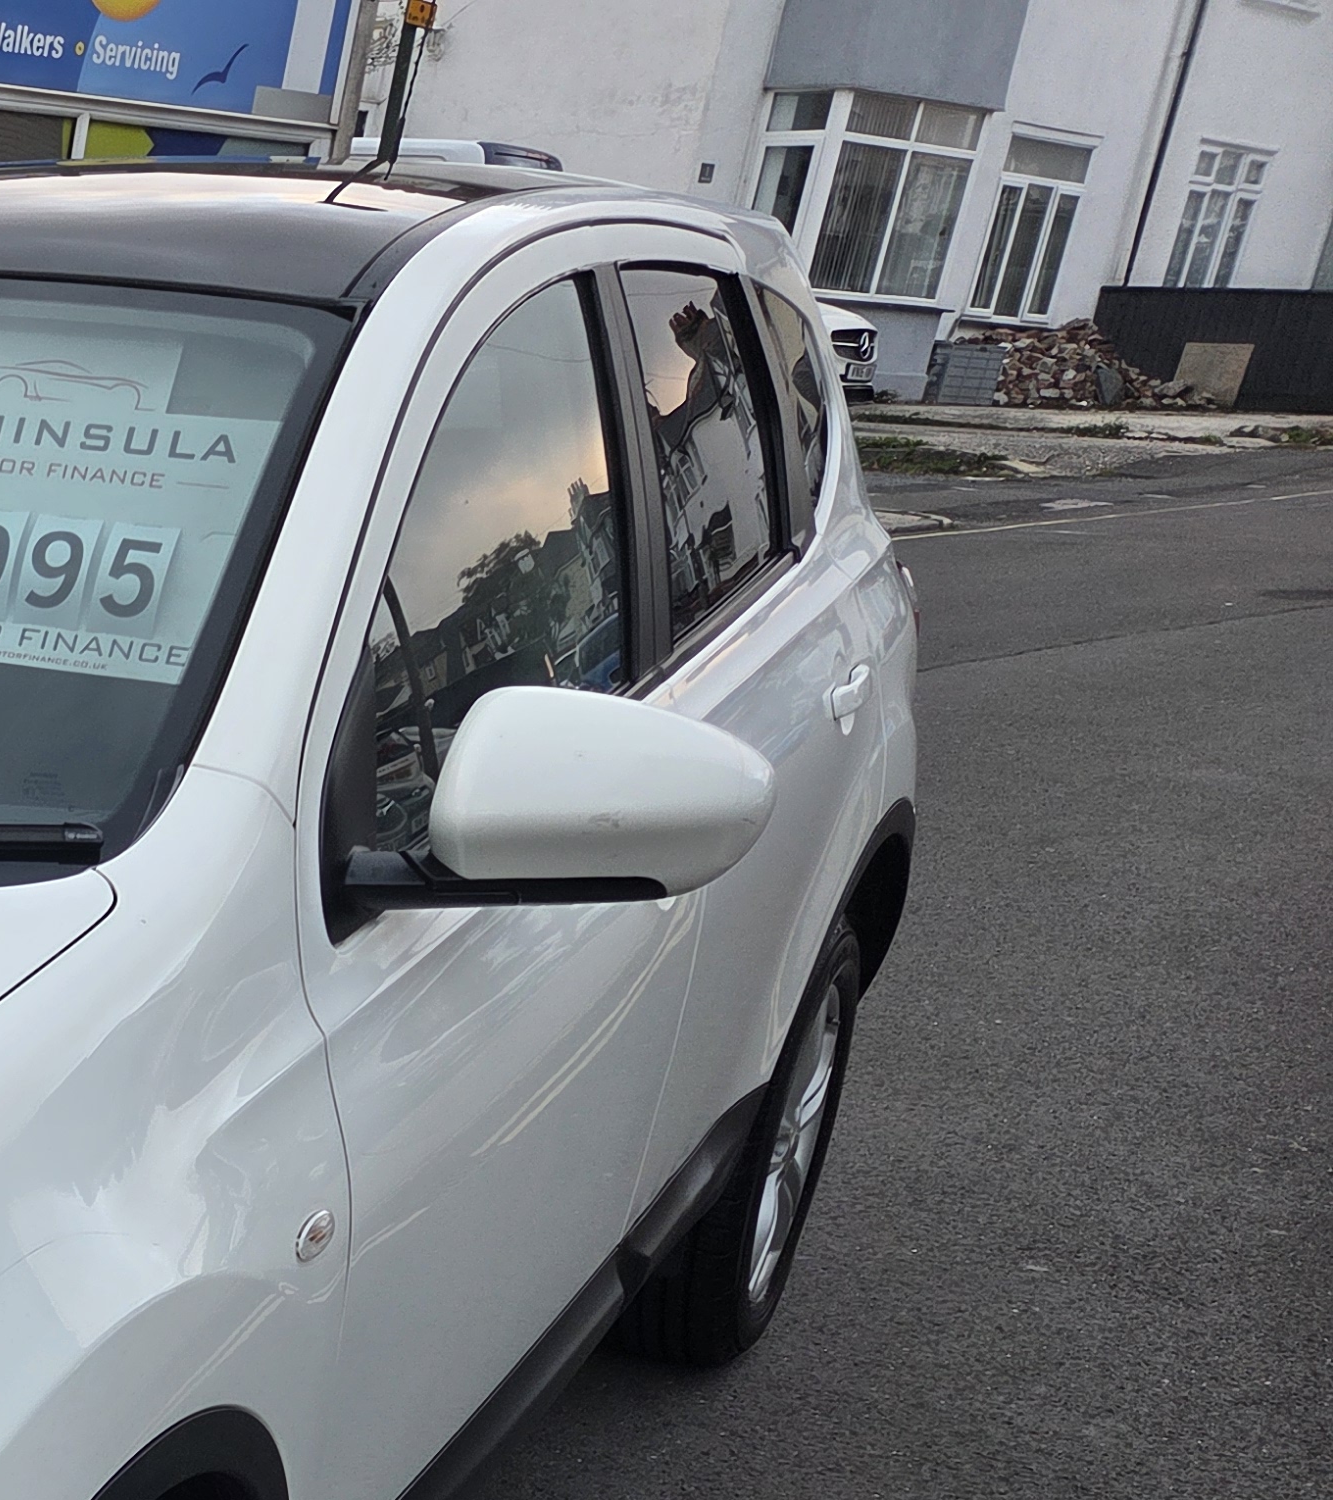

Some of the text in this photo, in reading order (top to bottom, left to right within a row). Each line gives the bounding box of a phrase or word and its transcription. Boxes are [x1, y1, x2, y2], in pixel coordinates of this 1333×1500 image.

[92, 35, 181, 80] Servicing
[46, 462, 166, 490] FINANCE
[17, 627, 191, 668] FINANCE
